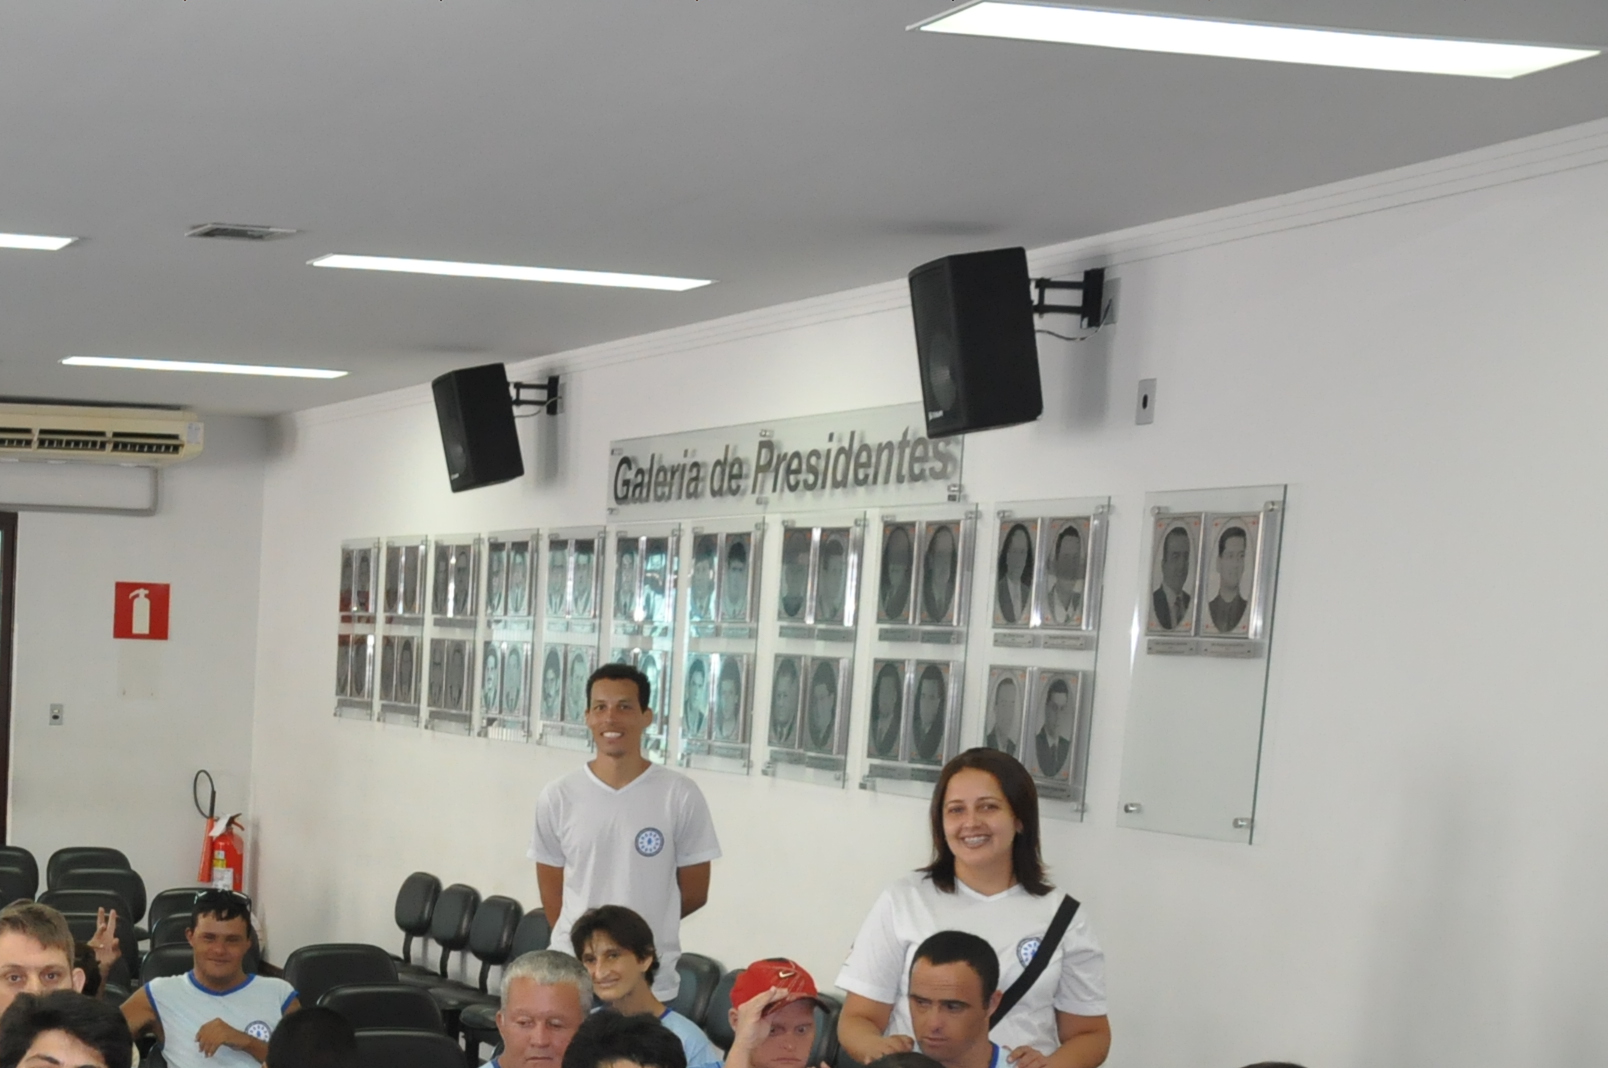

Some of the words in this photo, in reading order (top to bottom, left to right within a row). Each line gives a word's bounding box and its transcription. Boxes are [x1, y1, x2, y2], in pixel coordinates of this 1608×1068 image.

[613, 450, 701, 505] Galeria
[709, 444, 743, 497] de
[751, 426, 954, 494] Presidentes
